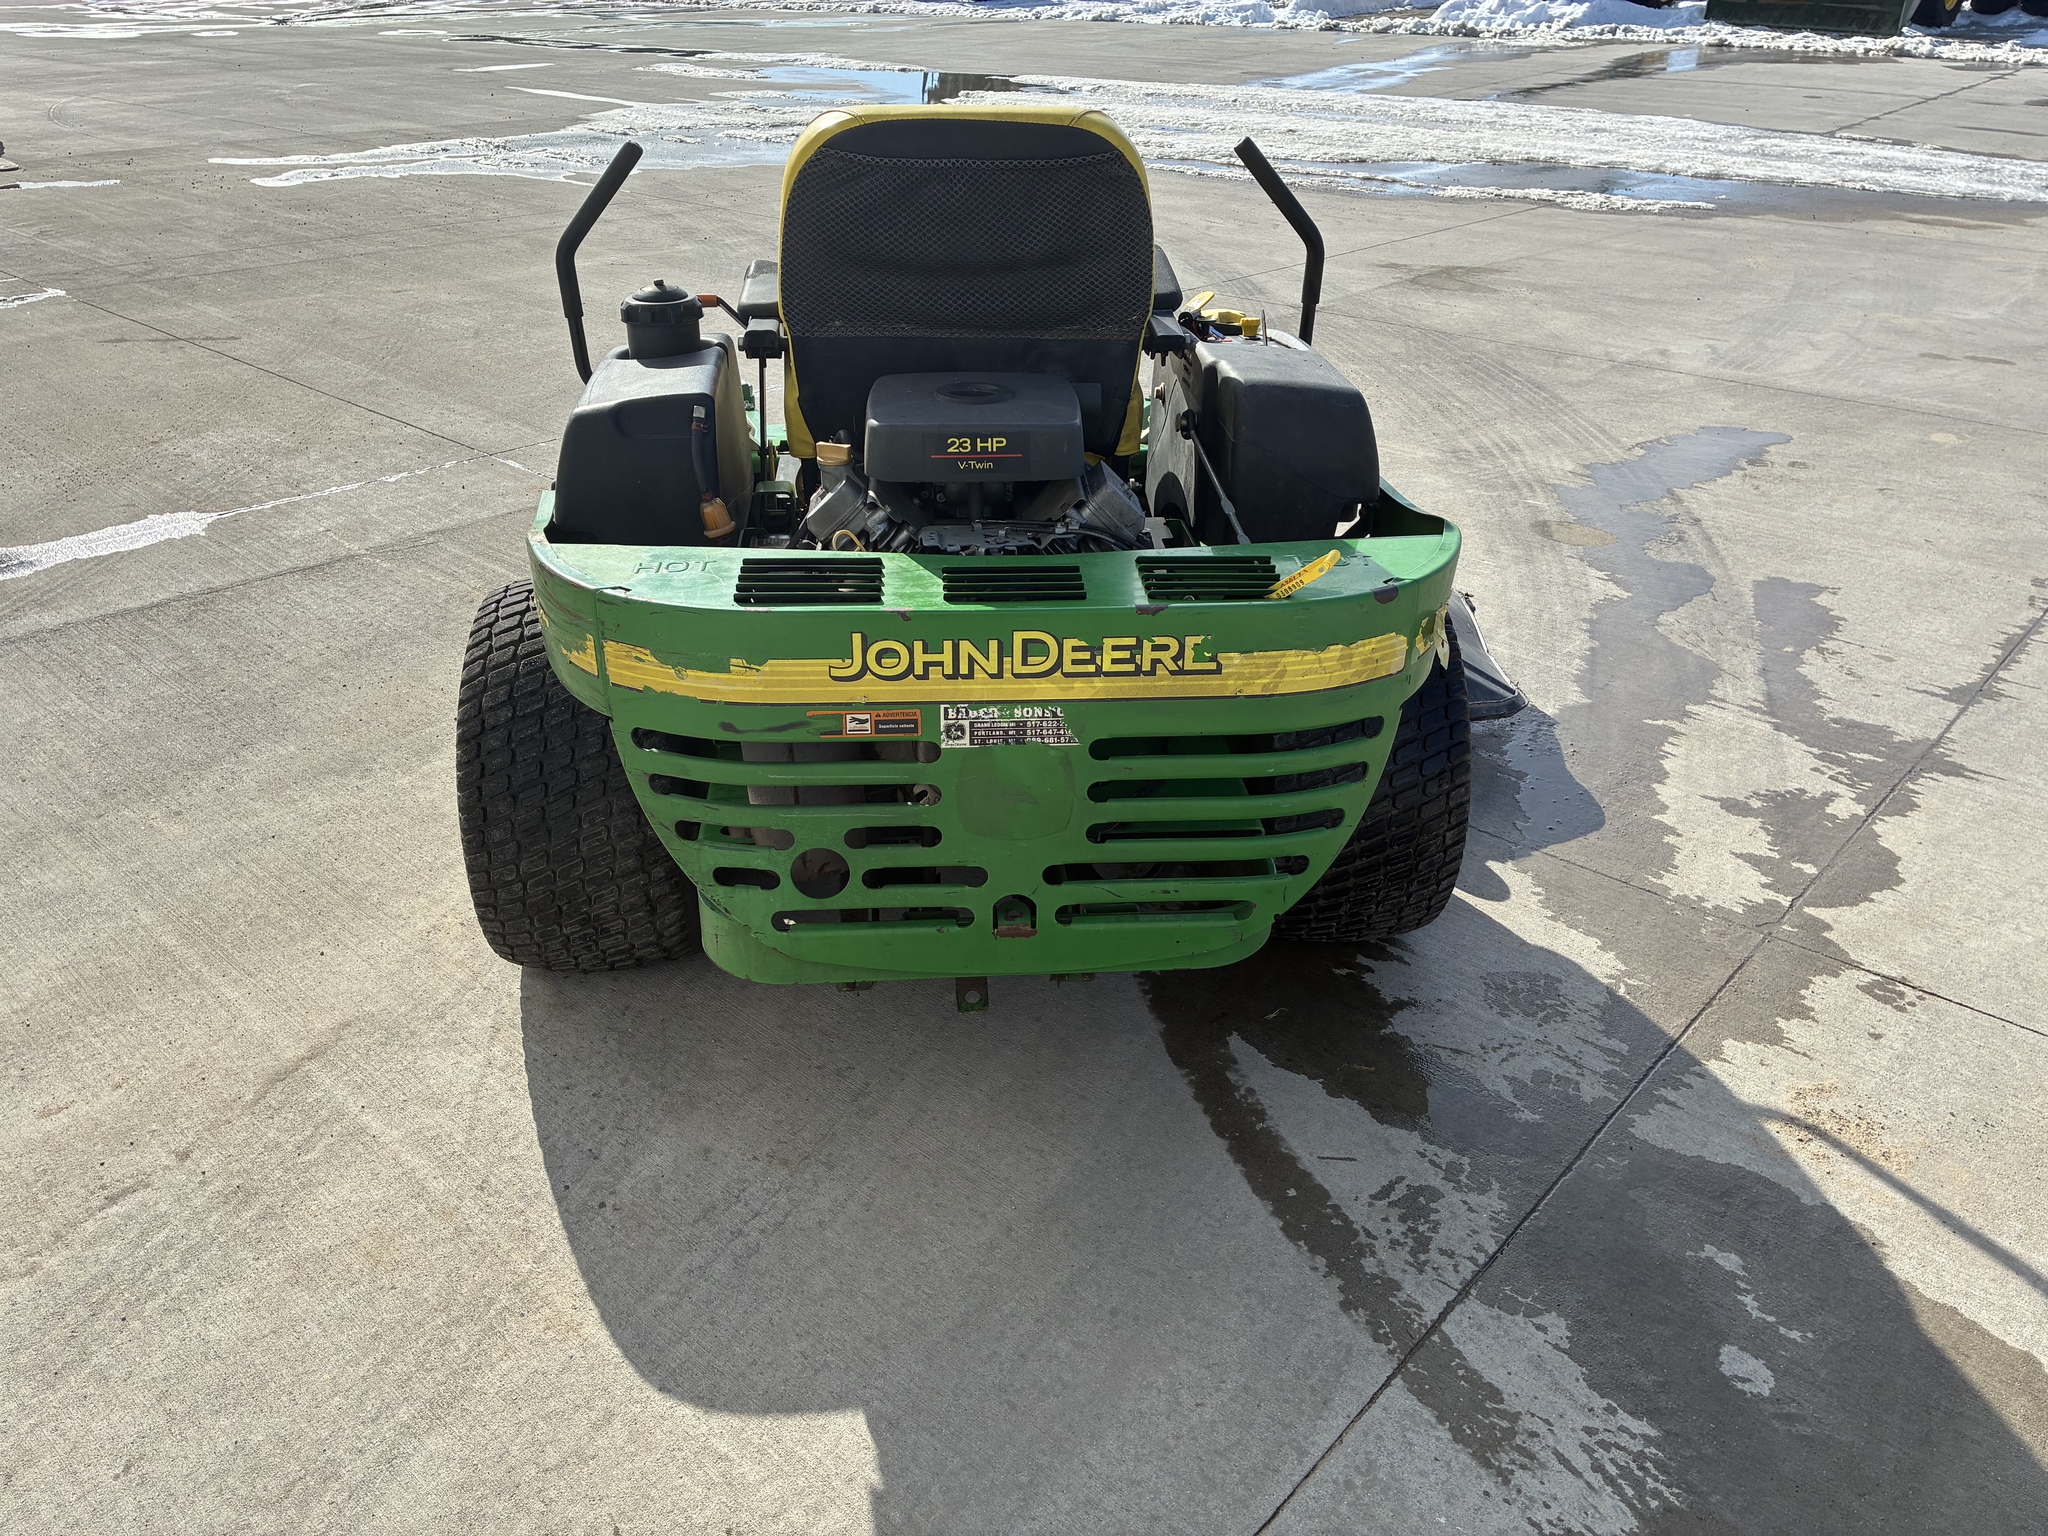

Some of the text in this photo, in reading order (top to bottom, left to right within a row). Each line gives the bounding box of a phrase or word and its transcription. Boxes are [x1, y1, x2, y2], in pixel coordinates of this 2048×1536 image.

[946, 437, 1007, 453] 23 HP
[957, 460, 994, 470] V-Twin
[633, 560, 718, 574] HOT
[829, 631, 1004, 683] JOHN
